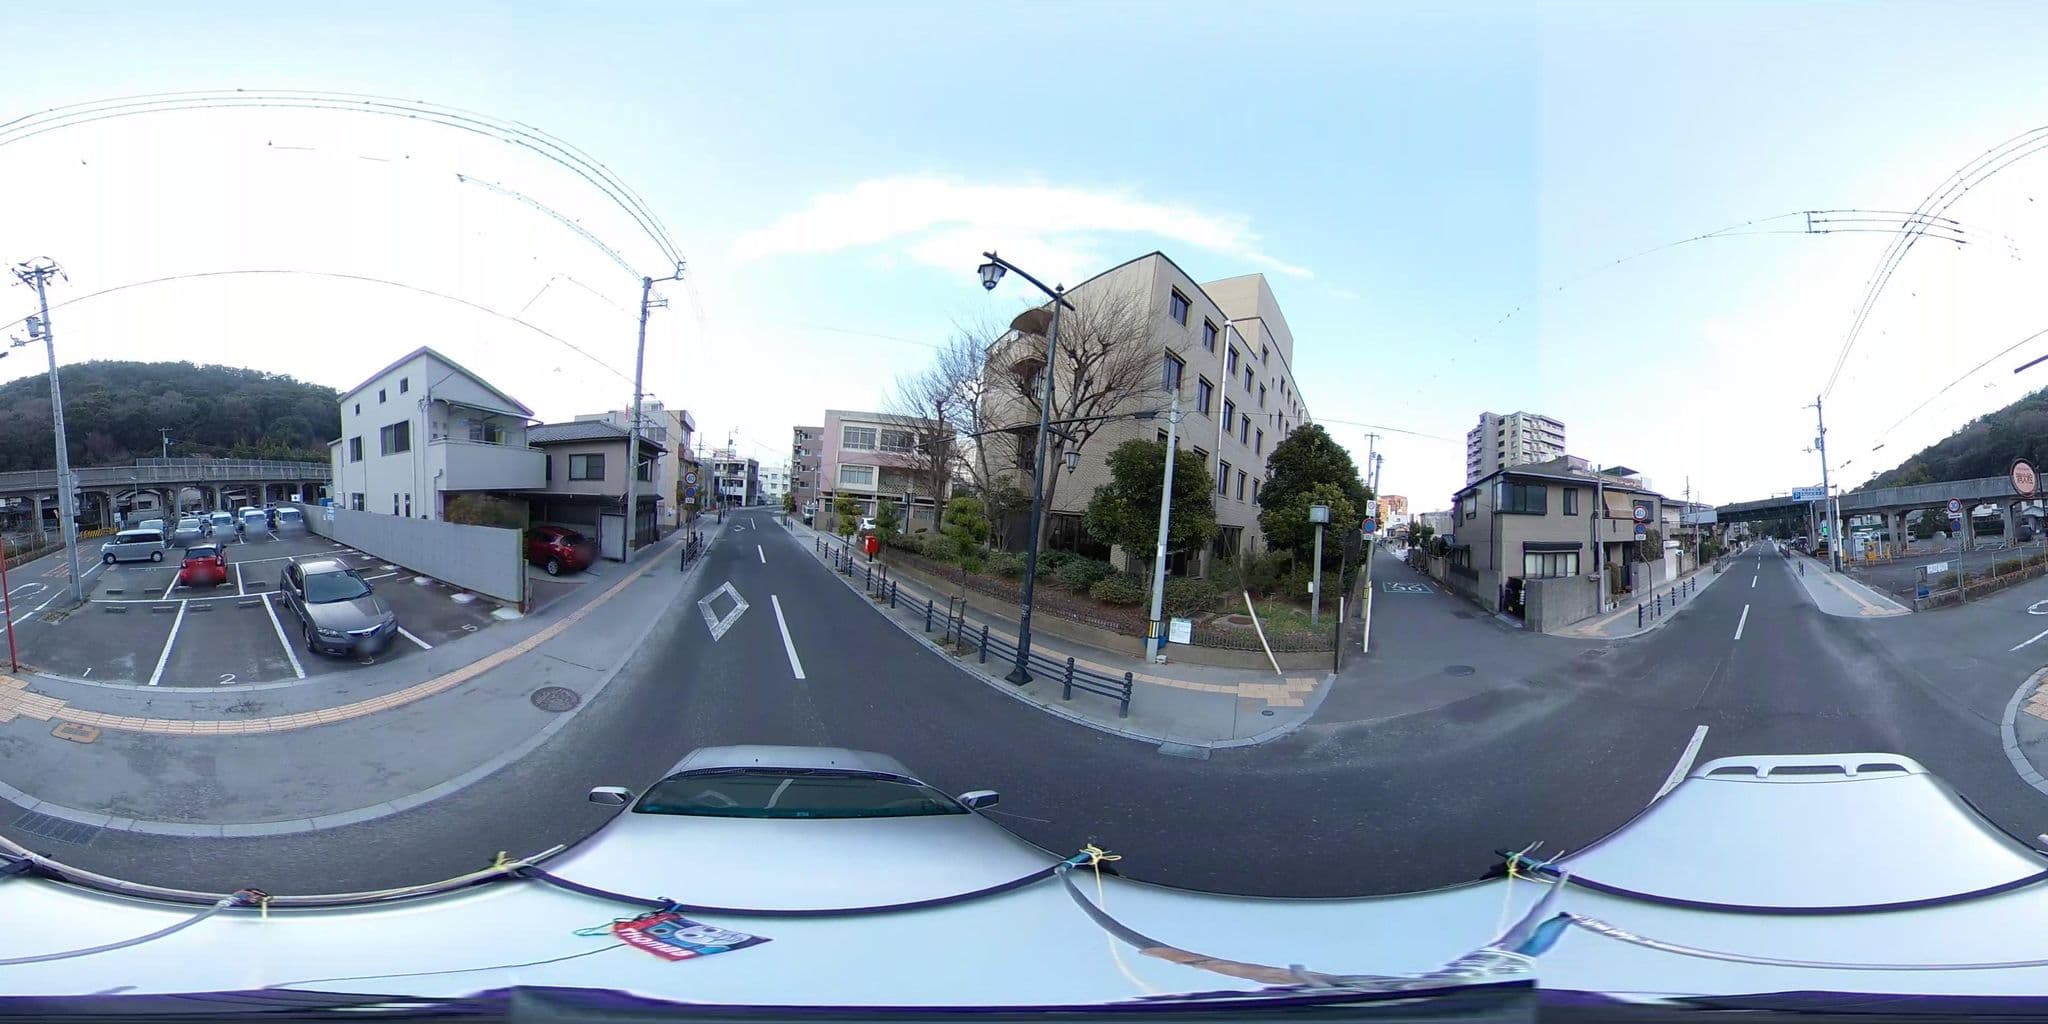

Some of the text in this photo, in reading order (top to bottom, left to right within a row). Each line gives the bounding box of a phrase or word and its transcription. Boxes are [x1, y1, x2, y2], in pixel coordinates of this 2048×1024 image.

[461, 623, 478, 632] 5
[83, 667, 92, 678] 1
[219, 673, 236, 685] 2
